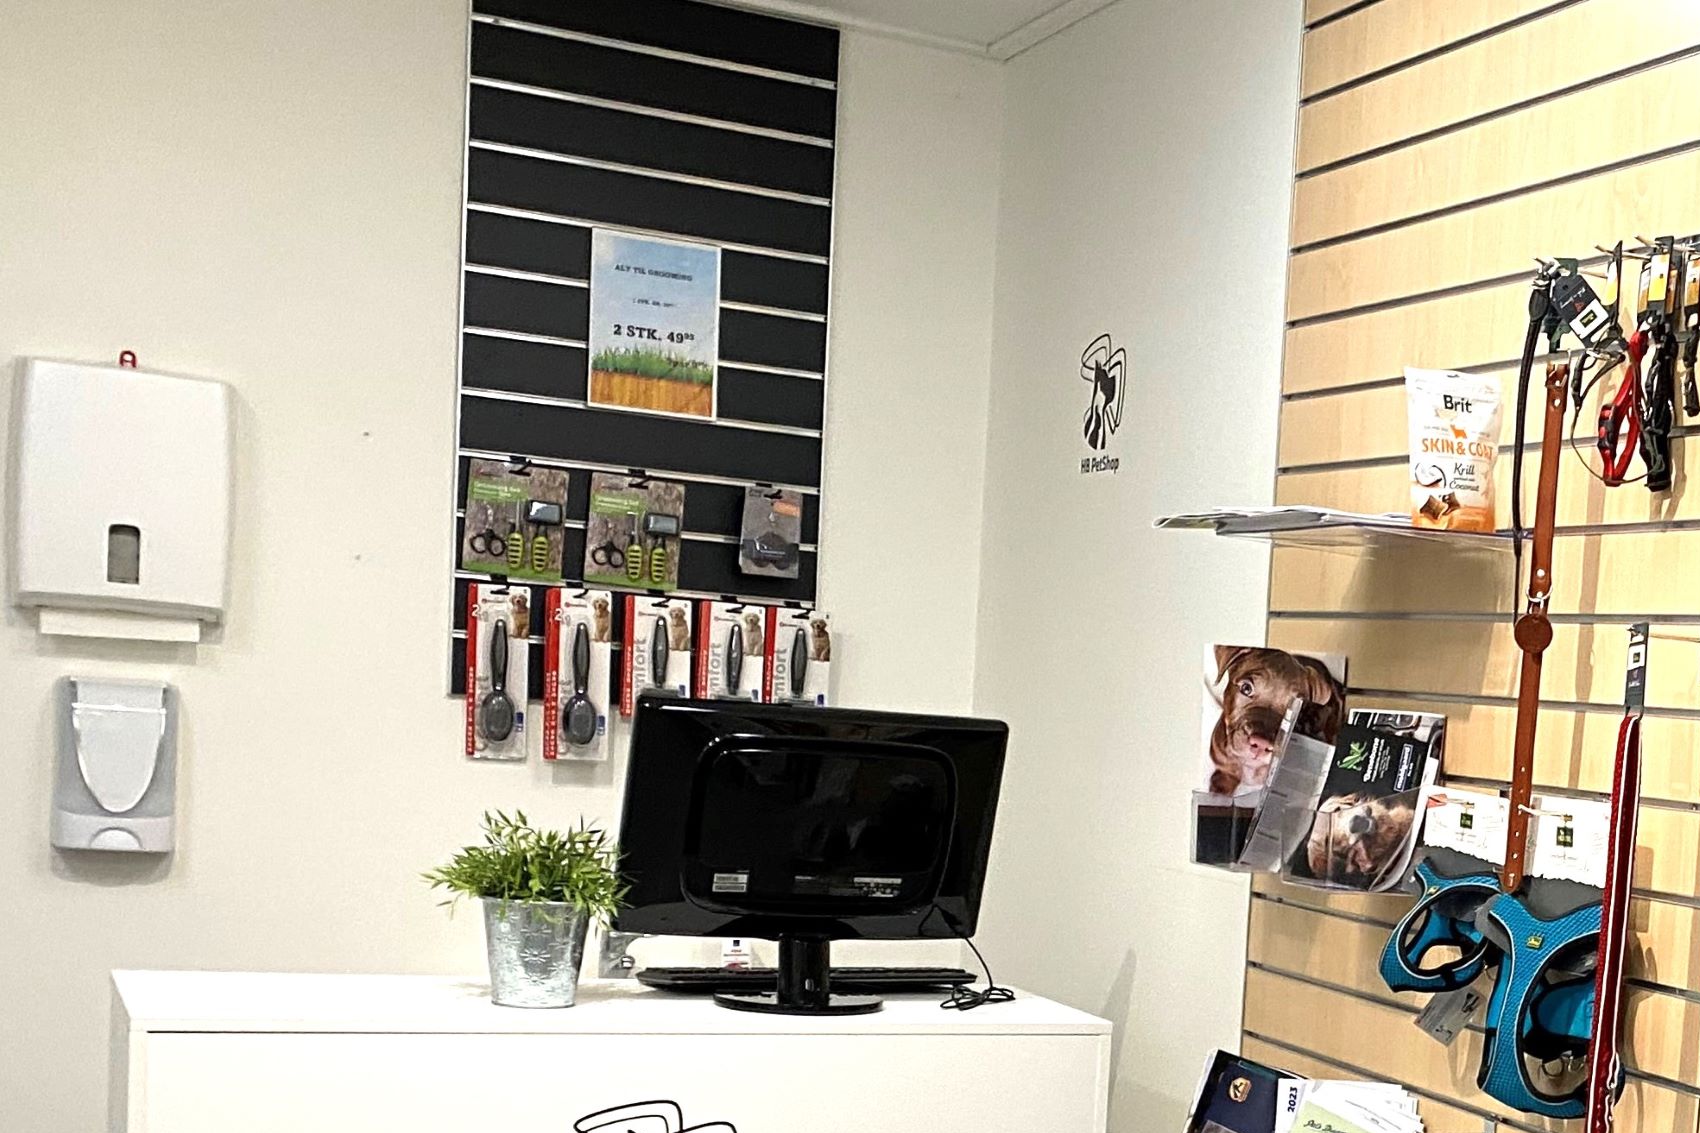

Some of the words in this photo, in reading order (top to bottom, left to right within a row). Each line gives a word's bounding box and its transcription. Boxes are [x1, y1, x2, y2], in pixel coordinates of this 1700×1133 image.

[613, 324, 622, 335] 2
[626, 325, 662, 341] STK.
[1443, 394, 1473, 414] Brit
[1422, 437, 1455, 455] SKIN
[1456, 442, 1466, 455] &
[1468, 441, 1493, 460] COAT
[1081, 458, 1090, 473] HB
[1091, 455, 1119, 474] PetShop
[1453, 462, 1475, 476] Krill
[1287, 1086, 1298, 1113] 2023
